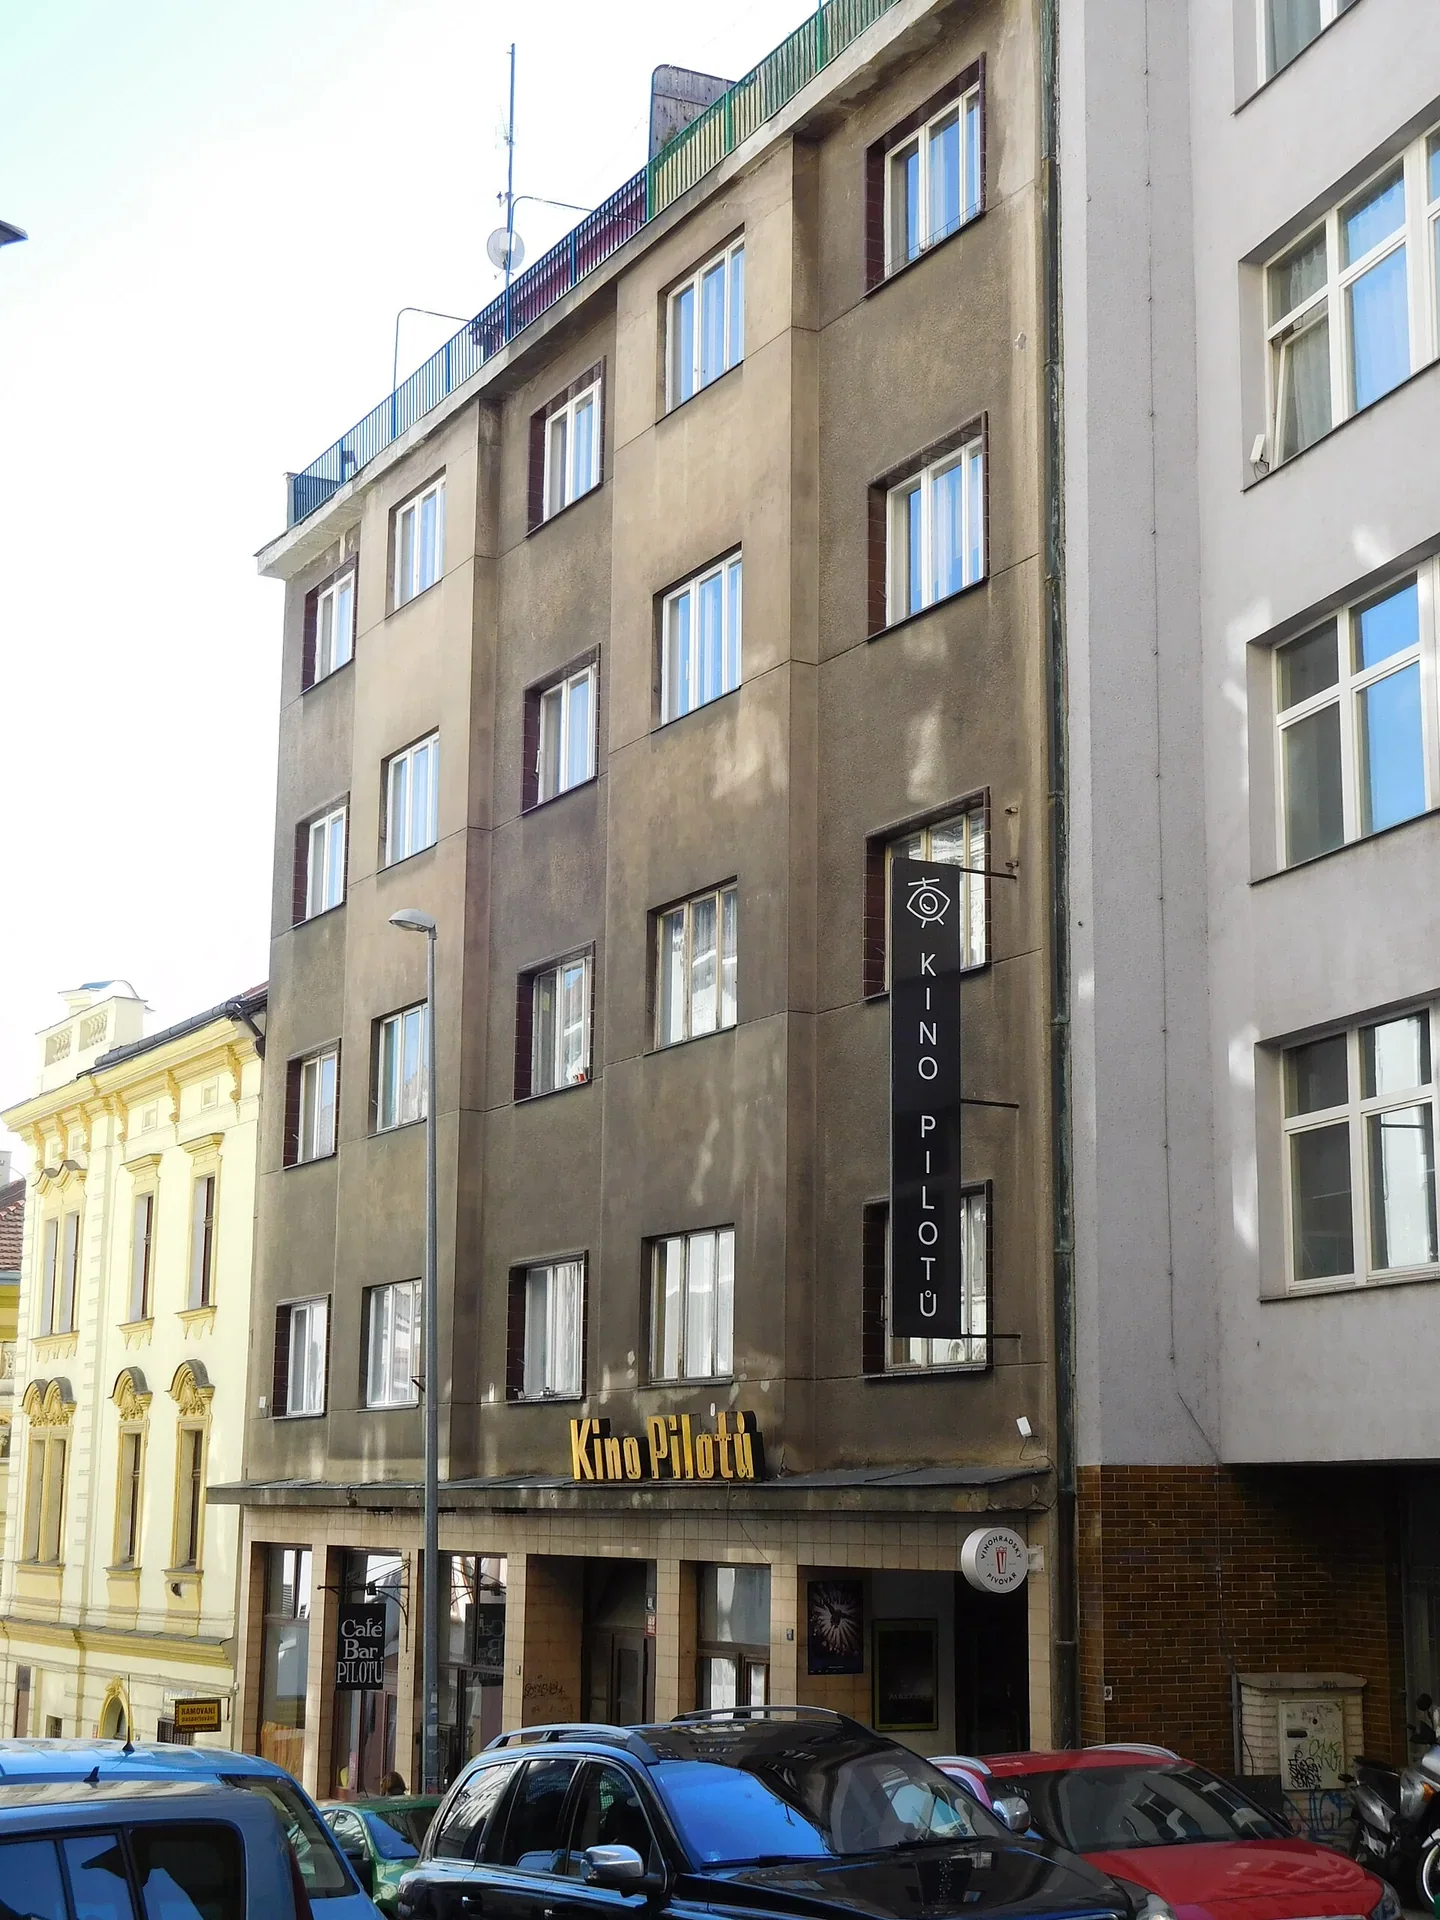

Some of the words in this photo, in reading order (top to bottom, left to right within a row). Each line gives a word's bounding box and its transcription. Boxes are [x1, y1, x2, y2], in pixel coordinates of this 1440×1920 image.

[918, 952, 939, 1081] KINO
[918, 1115, 939, 1317] PILOTŮ
[570, 1417, 642, 1480] Kino
[986, 1572, 1017, 1585] PIVOVAR
[340, 1617, 383, 1638] Café
[343, 1638, 378, 1660] Bar
[336, 1657, 384, 1683] PILOTŮ
